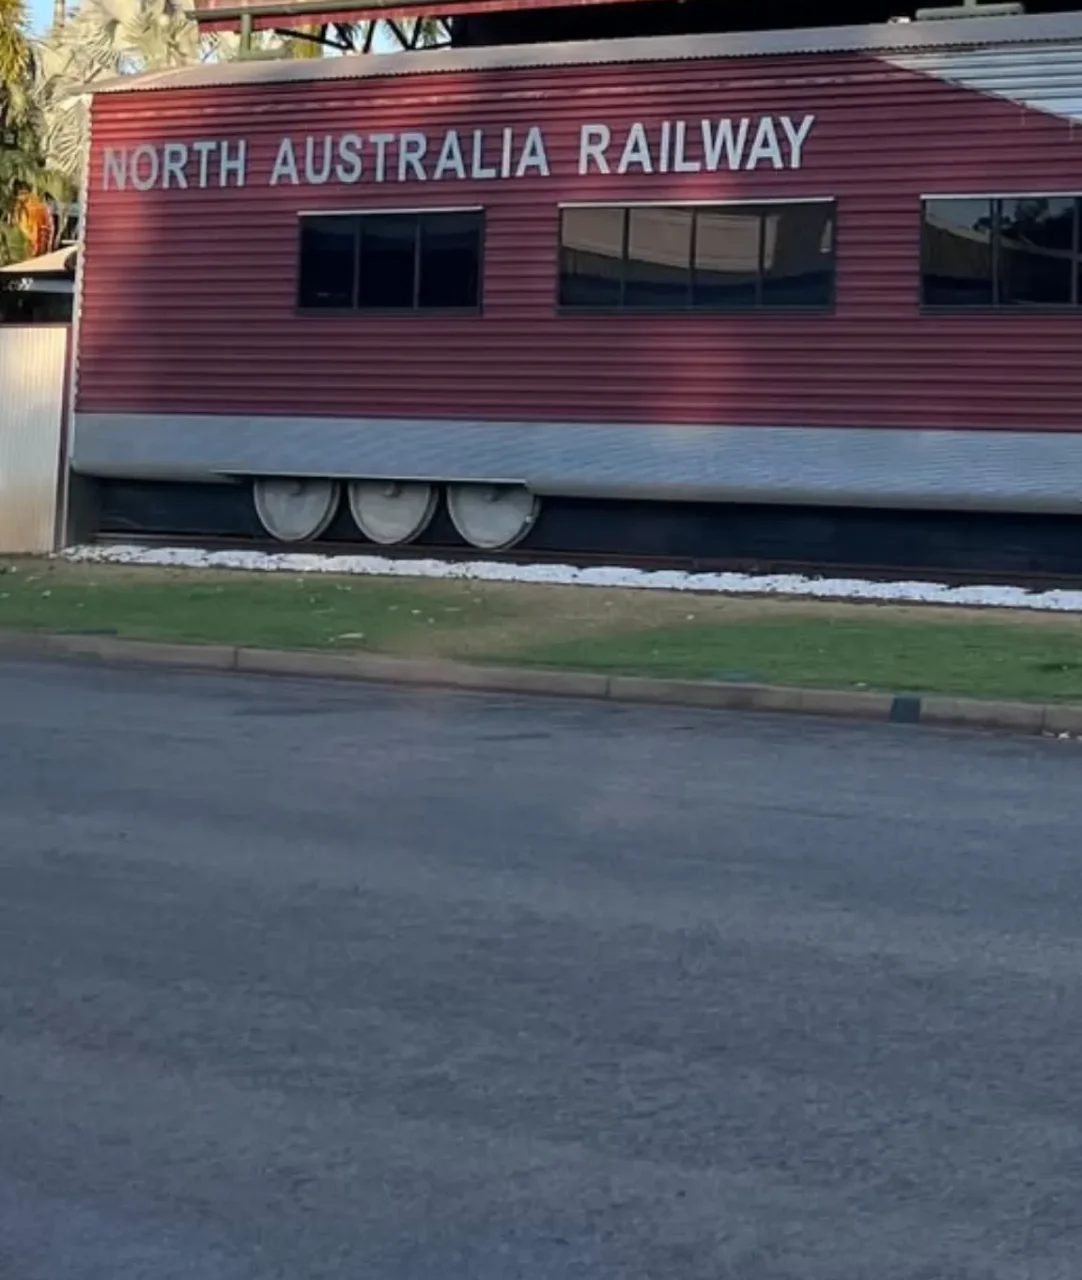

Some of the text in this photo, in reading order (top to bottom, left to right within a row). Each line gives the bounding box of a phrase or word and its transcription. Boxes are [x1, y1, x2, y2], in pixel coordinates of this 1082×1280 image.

[102, 114, 815, 191] NORTH AUSTRALIA RAILWAY
